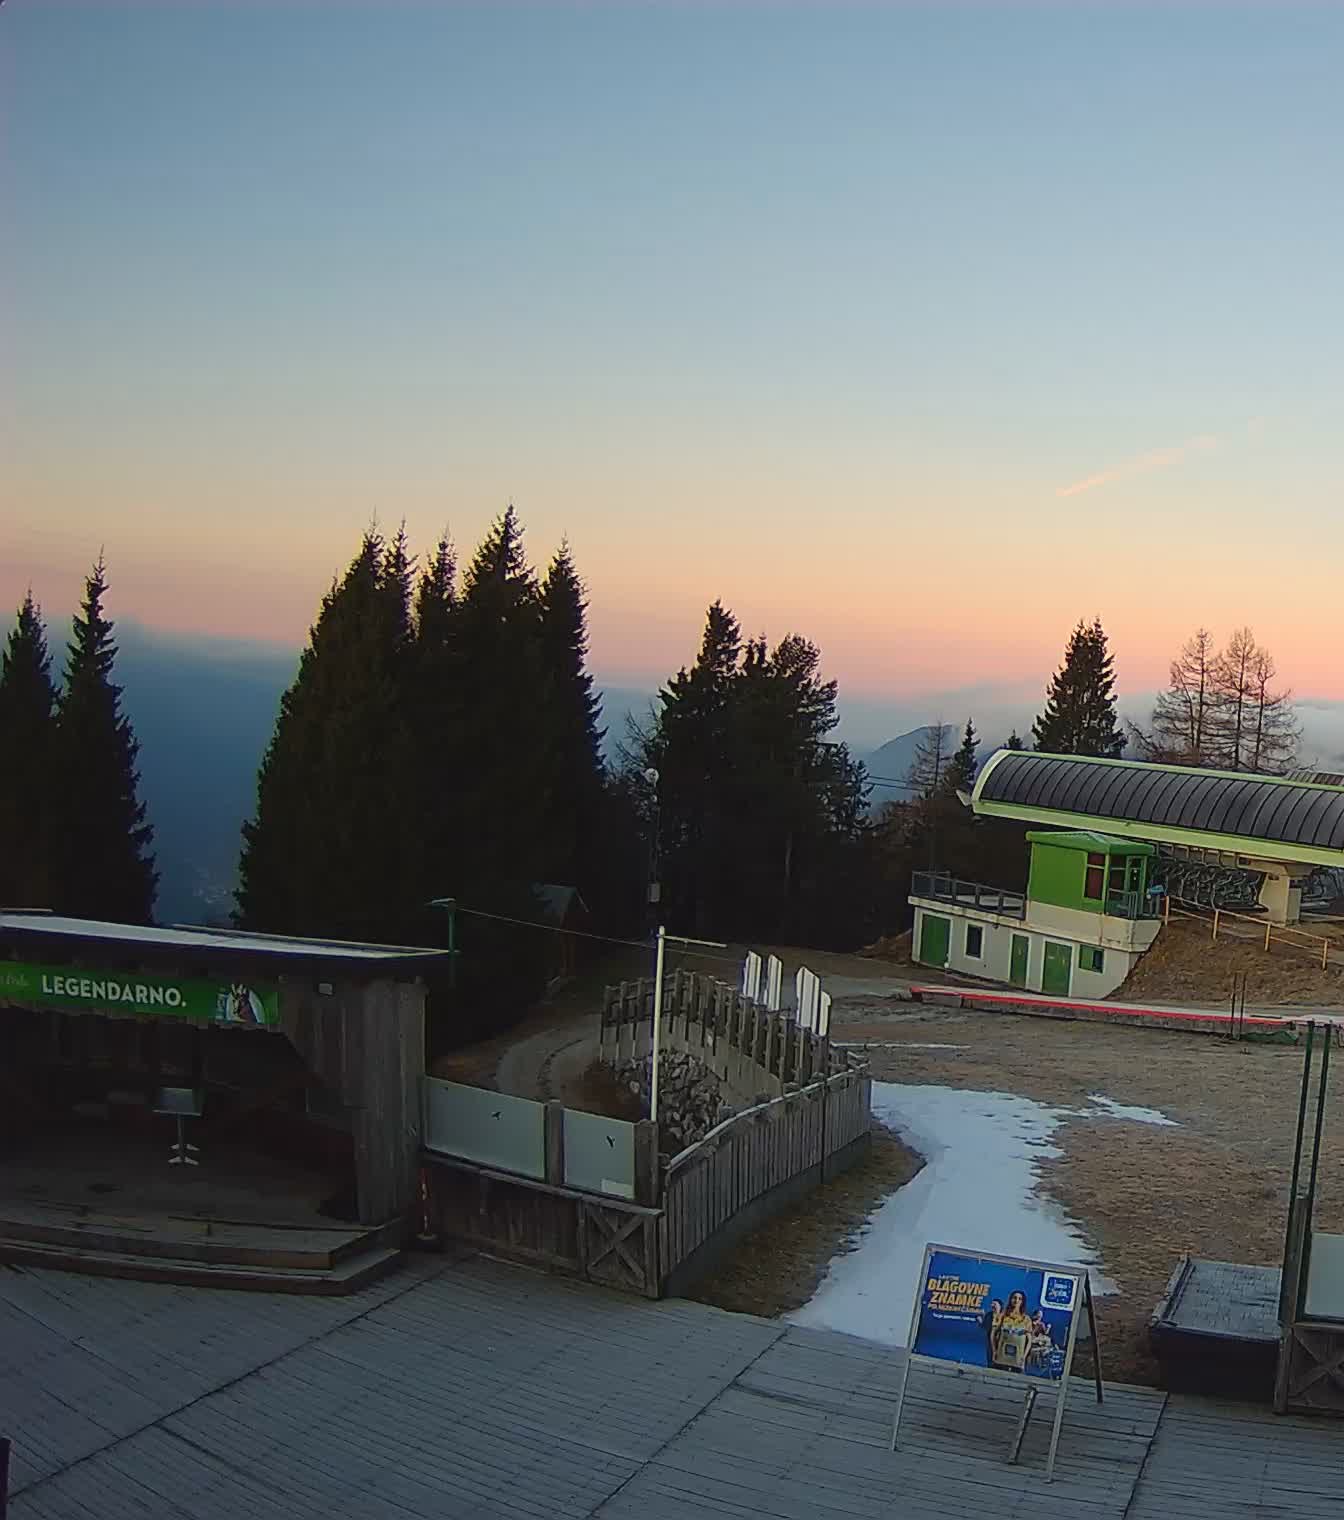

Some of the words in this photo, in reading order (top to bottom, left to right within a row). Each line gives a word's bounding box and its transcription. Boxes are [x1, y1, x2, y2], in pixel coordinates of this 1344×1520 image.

[41, 974, 187, 1008] LEGENDARNO.
[928, 1279, 991, 1296] BLAGOVNE
[930, 1292, 984, 1307] ZNAMKE
